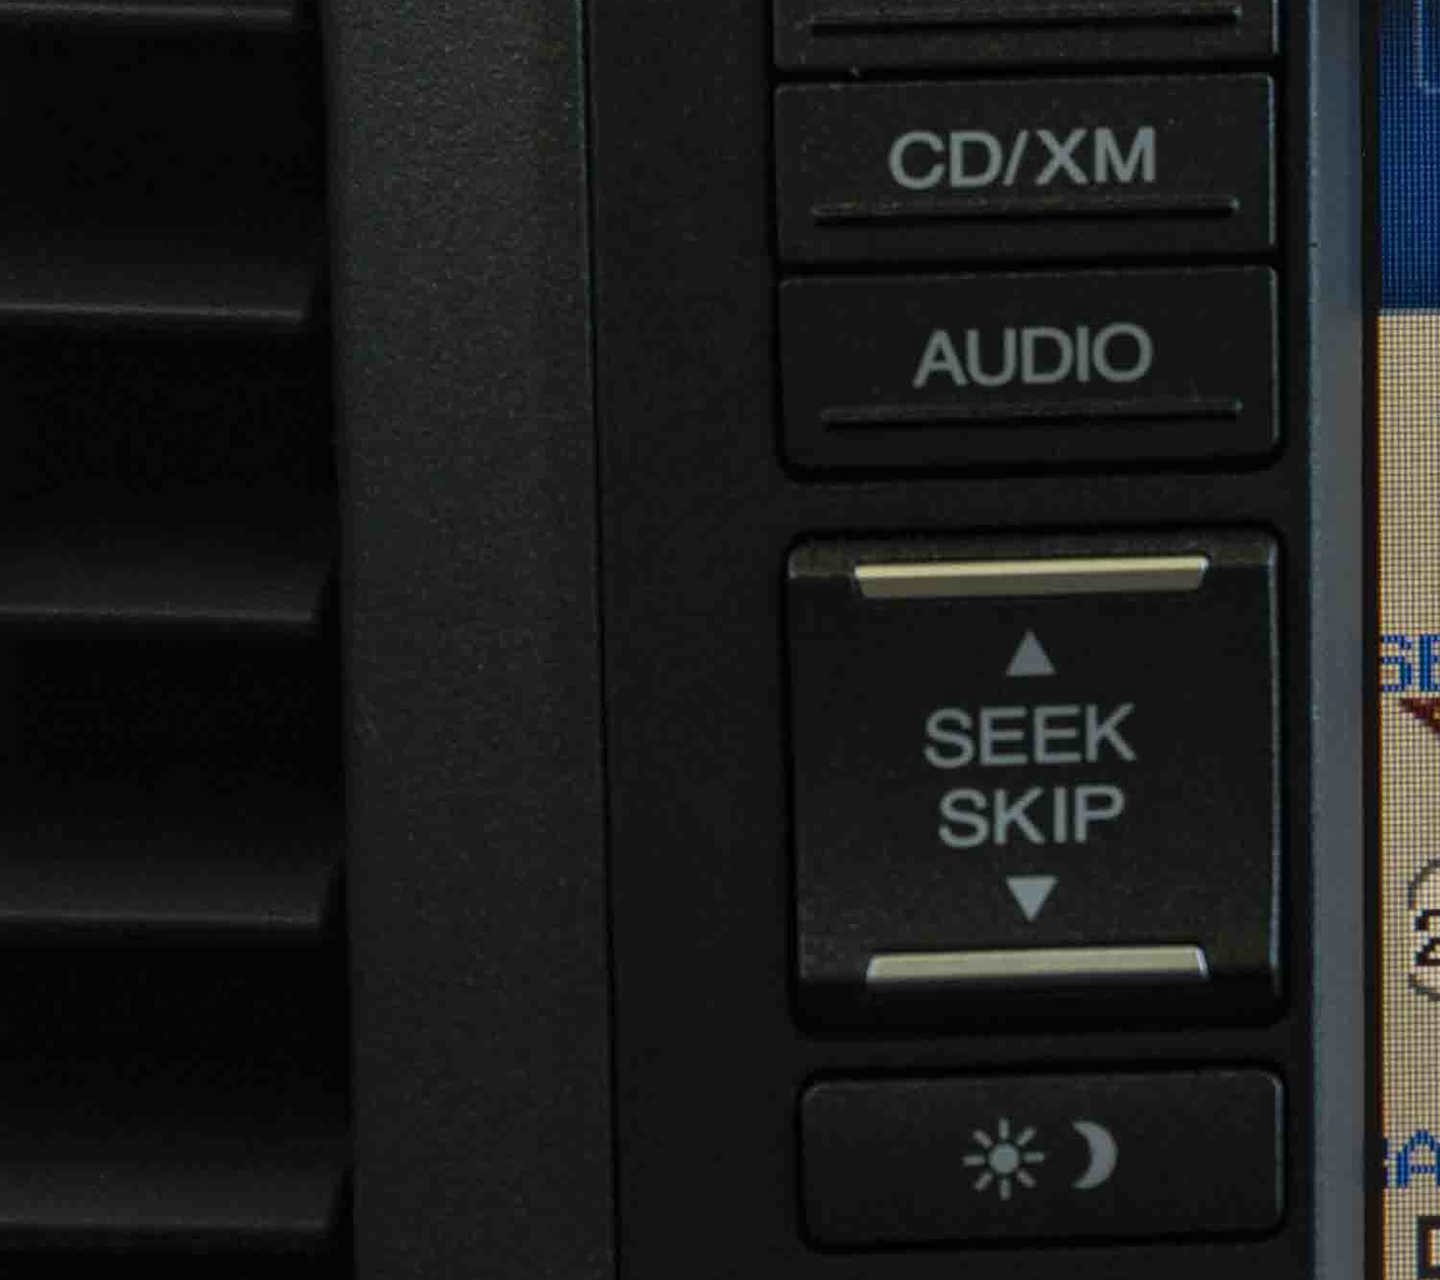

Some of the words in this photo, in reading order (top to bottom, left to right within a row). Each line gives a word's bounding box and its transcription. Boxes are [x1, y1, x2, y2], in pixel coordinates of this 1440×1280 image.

[887, 127, 1157, 191] CD/XM
[912, 322, 1154, 388] AUDIO
[923, 704, 1137, 769] SEEK
[938, 786, 1126, 848] SKIP
